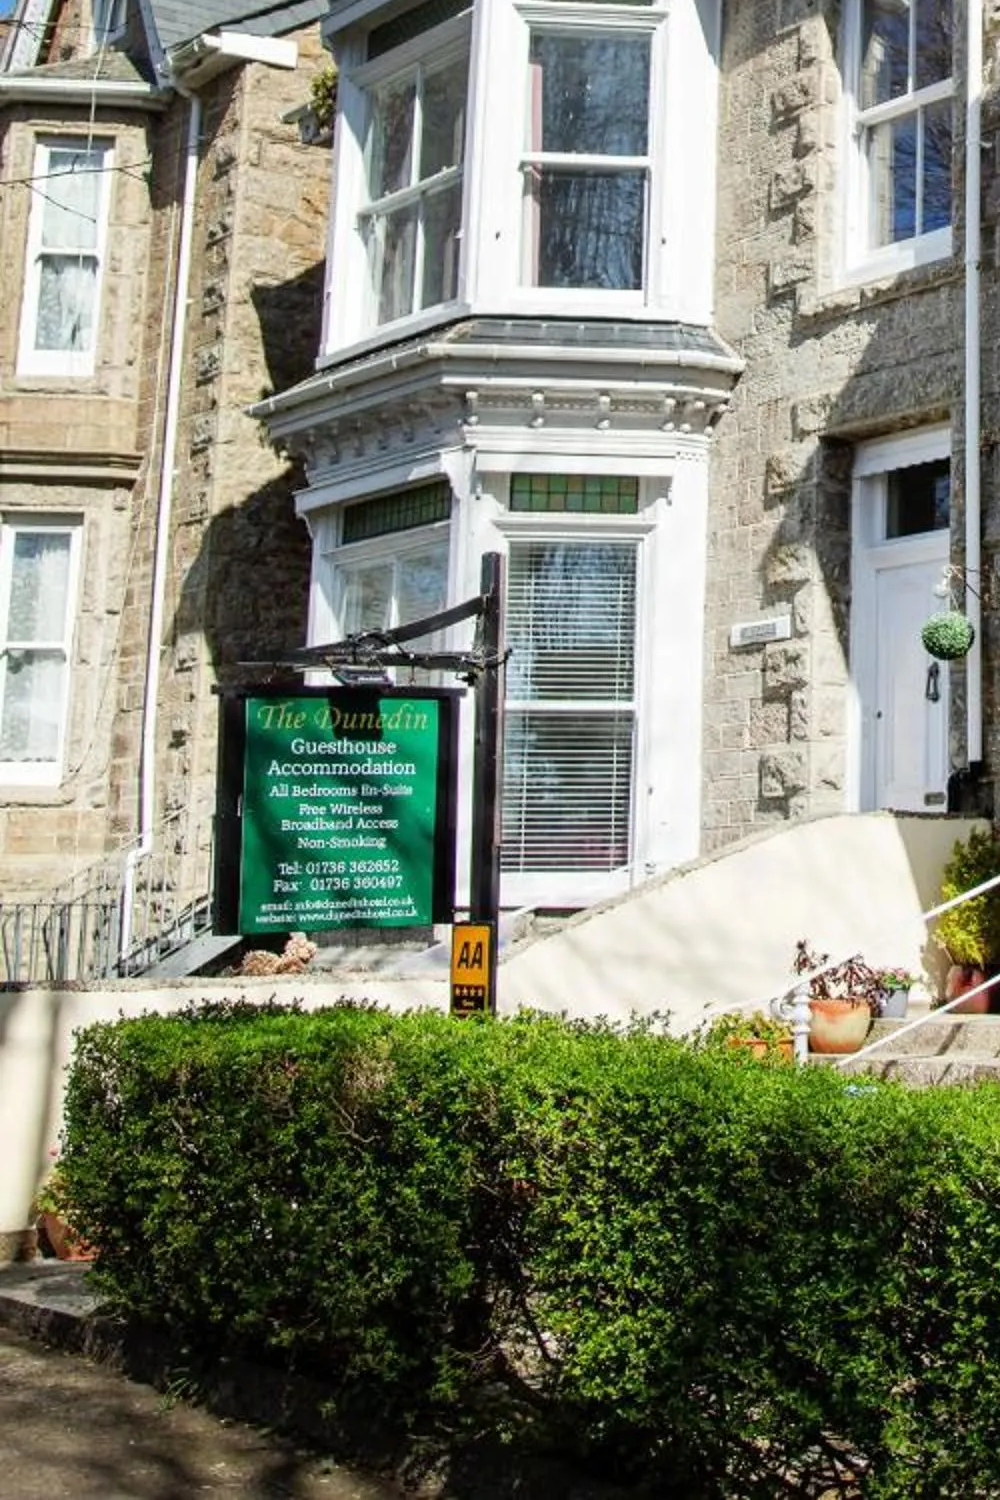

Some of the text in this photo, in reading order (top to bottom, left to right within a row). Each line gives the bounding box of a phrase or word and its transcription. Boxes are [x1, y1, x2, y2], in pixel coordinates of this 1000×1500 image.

[257, 702, 428, 731] The Dunedin
[291, 737, 397, 755] Guesthouse
[268, 758, 416, 776] Accommodation
[269, 784, 413, 797] All Bedrooms En-Suite
[299, 802, 383, 815] Free Wireless
[281, 817, 399, 831] Broadband Access
[297, 836, 387, 850] Non-Smoking
[277, 862, 301, 875] Tel:
[305, 861, 345, 874] 01736
[311, 878, 350, 891] 01736
[457, 941, 483, 969] AA
